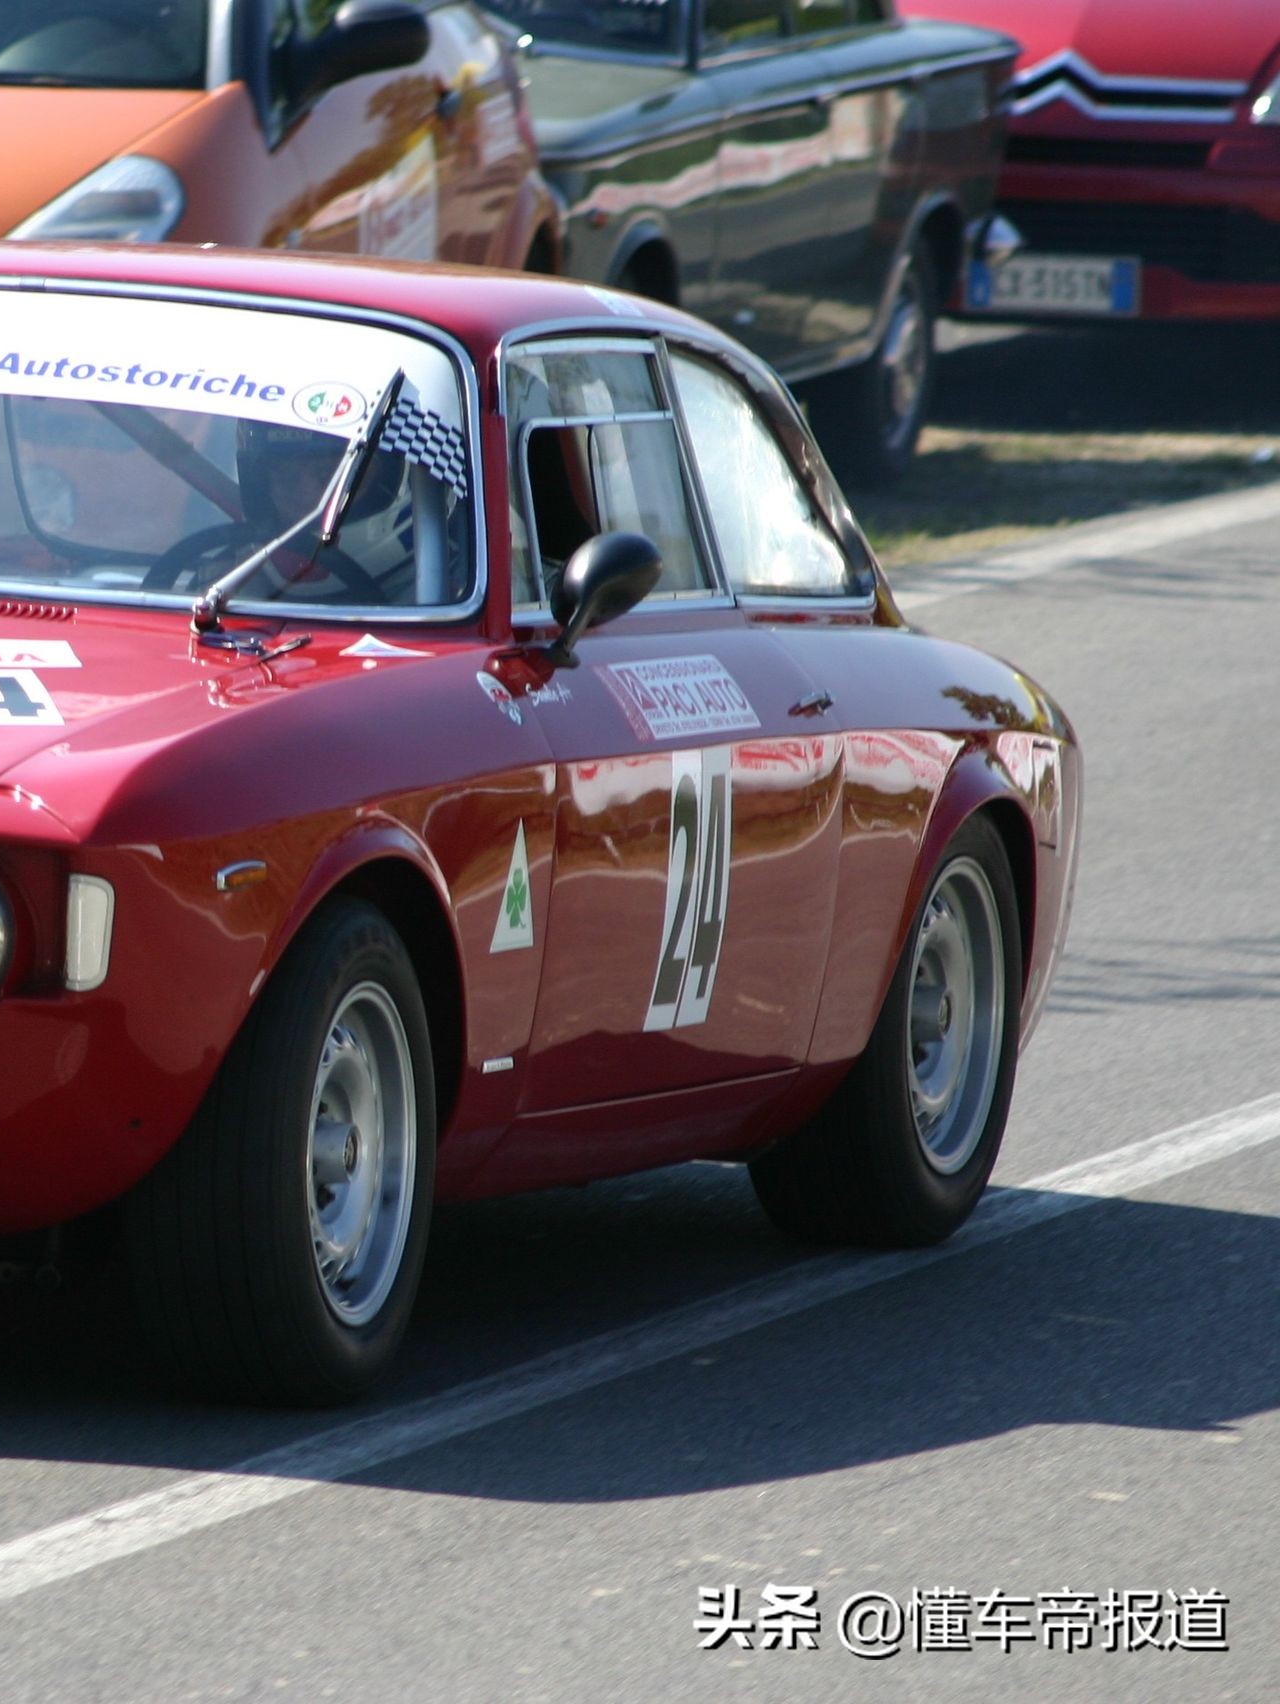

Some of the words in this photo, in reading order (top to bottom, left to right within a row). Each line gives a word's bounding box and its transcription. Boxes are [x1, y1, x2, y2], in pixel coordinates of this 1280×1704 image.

[649, 680, 703, 719] PACI
[694, 677, 748, 713] AUTO
[651, 773, 727, 1006] 24
